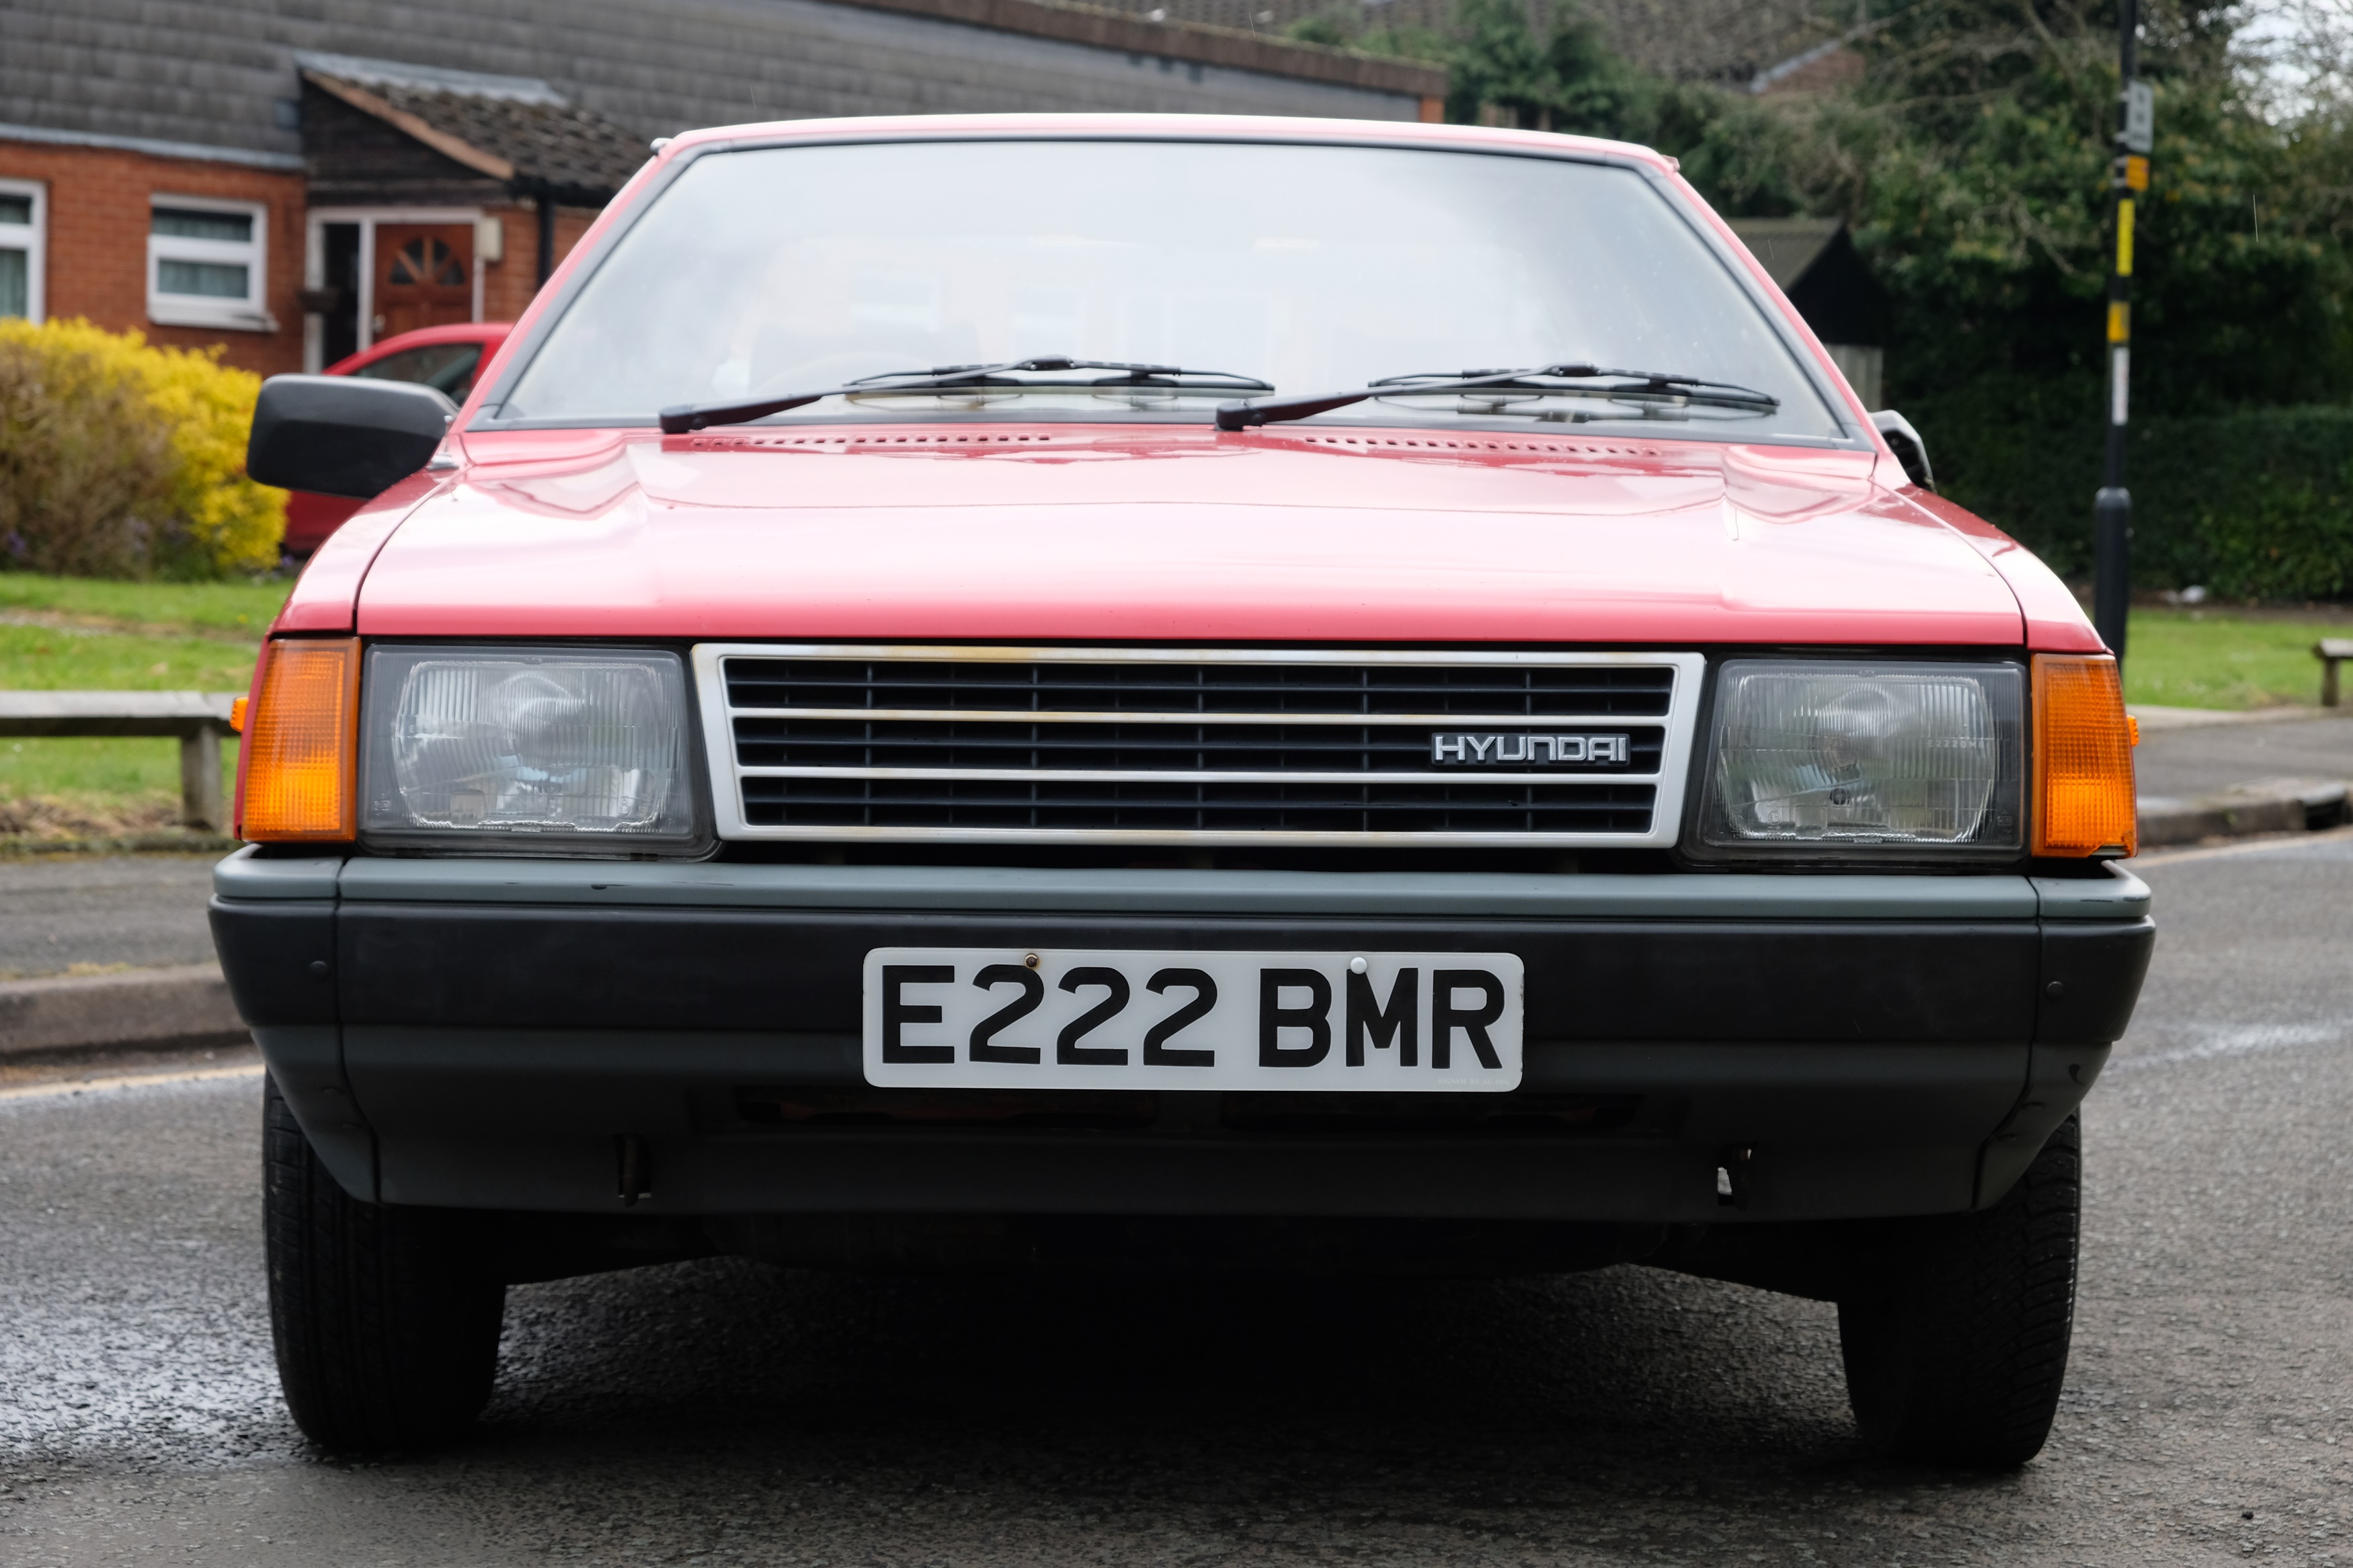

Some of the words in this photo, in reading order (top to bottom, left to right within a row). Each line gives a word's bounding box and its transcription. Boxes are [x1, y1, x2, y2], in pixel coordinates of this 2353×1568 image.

[1435, 736, 1626, 761] HYUNDAI
[881, 964, 1218, 1067] E222
[1258, 966, 1505, 1069] BMR
